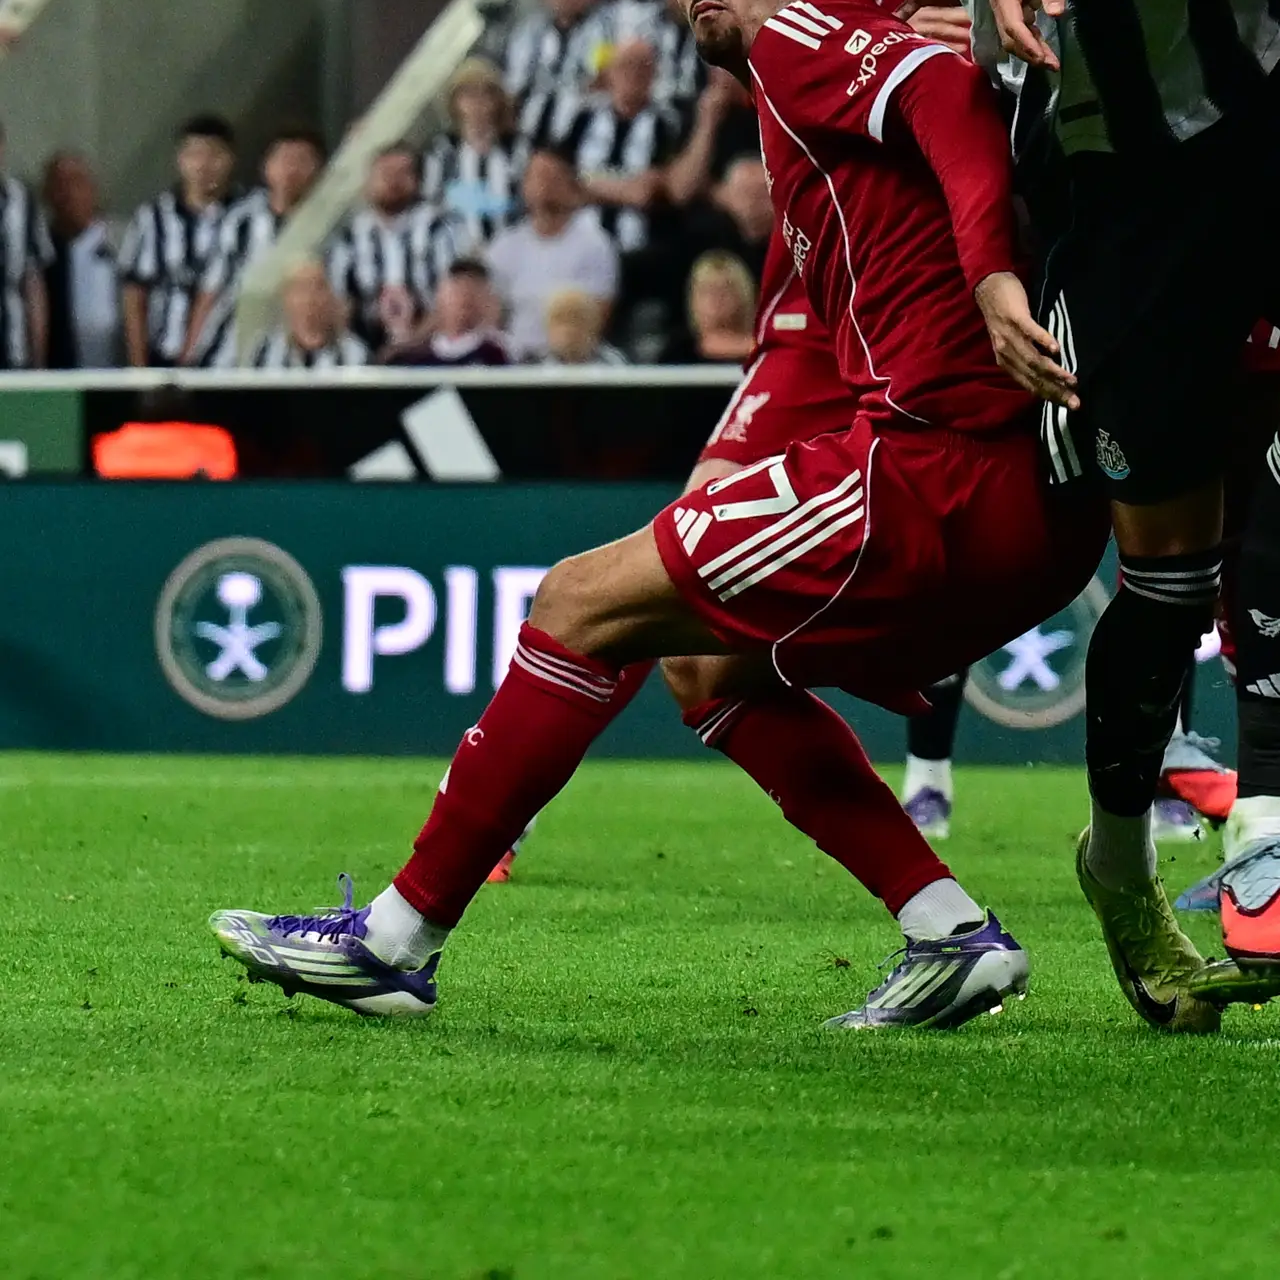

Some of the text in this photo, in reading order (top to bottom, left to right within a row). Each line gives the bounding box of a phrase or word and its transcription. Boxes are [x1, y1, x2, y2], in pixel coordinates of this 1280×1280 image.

[846, 31, 925, 97] Expedi
[706, 454, 800, 522] 17
[340, 564, 549, 694] PIF
